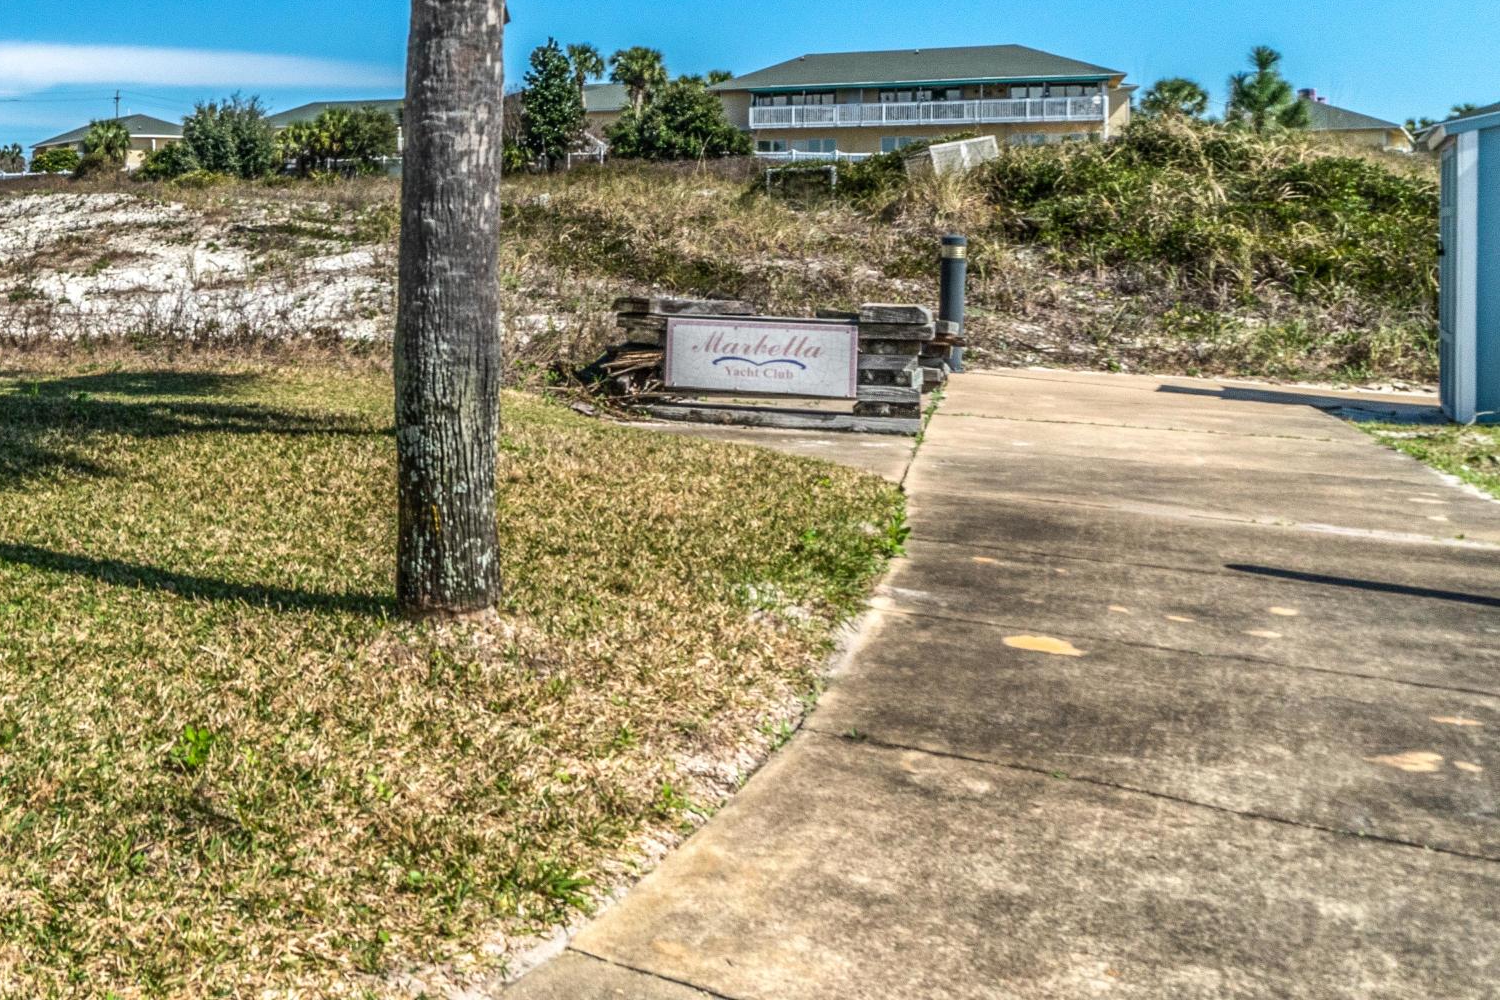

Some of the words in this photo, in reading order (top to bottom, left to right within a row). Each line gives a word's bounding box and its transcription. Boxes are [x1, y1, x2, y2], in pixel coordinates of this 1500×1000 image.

[692, 331, 823, 358] Marbella
[724, 366, 759, 377] Yacht
[763, 368, 794, 379] Club
